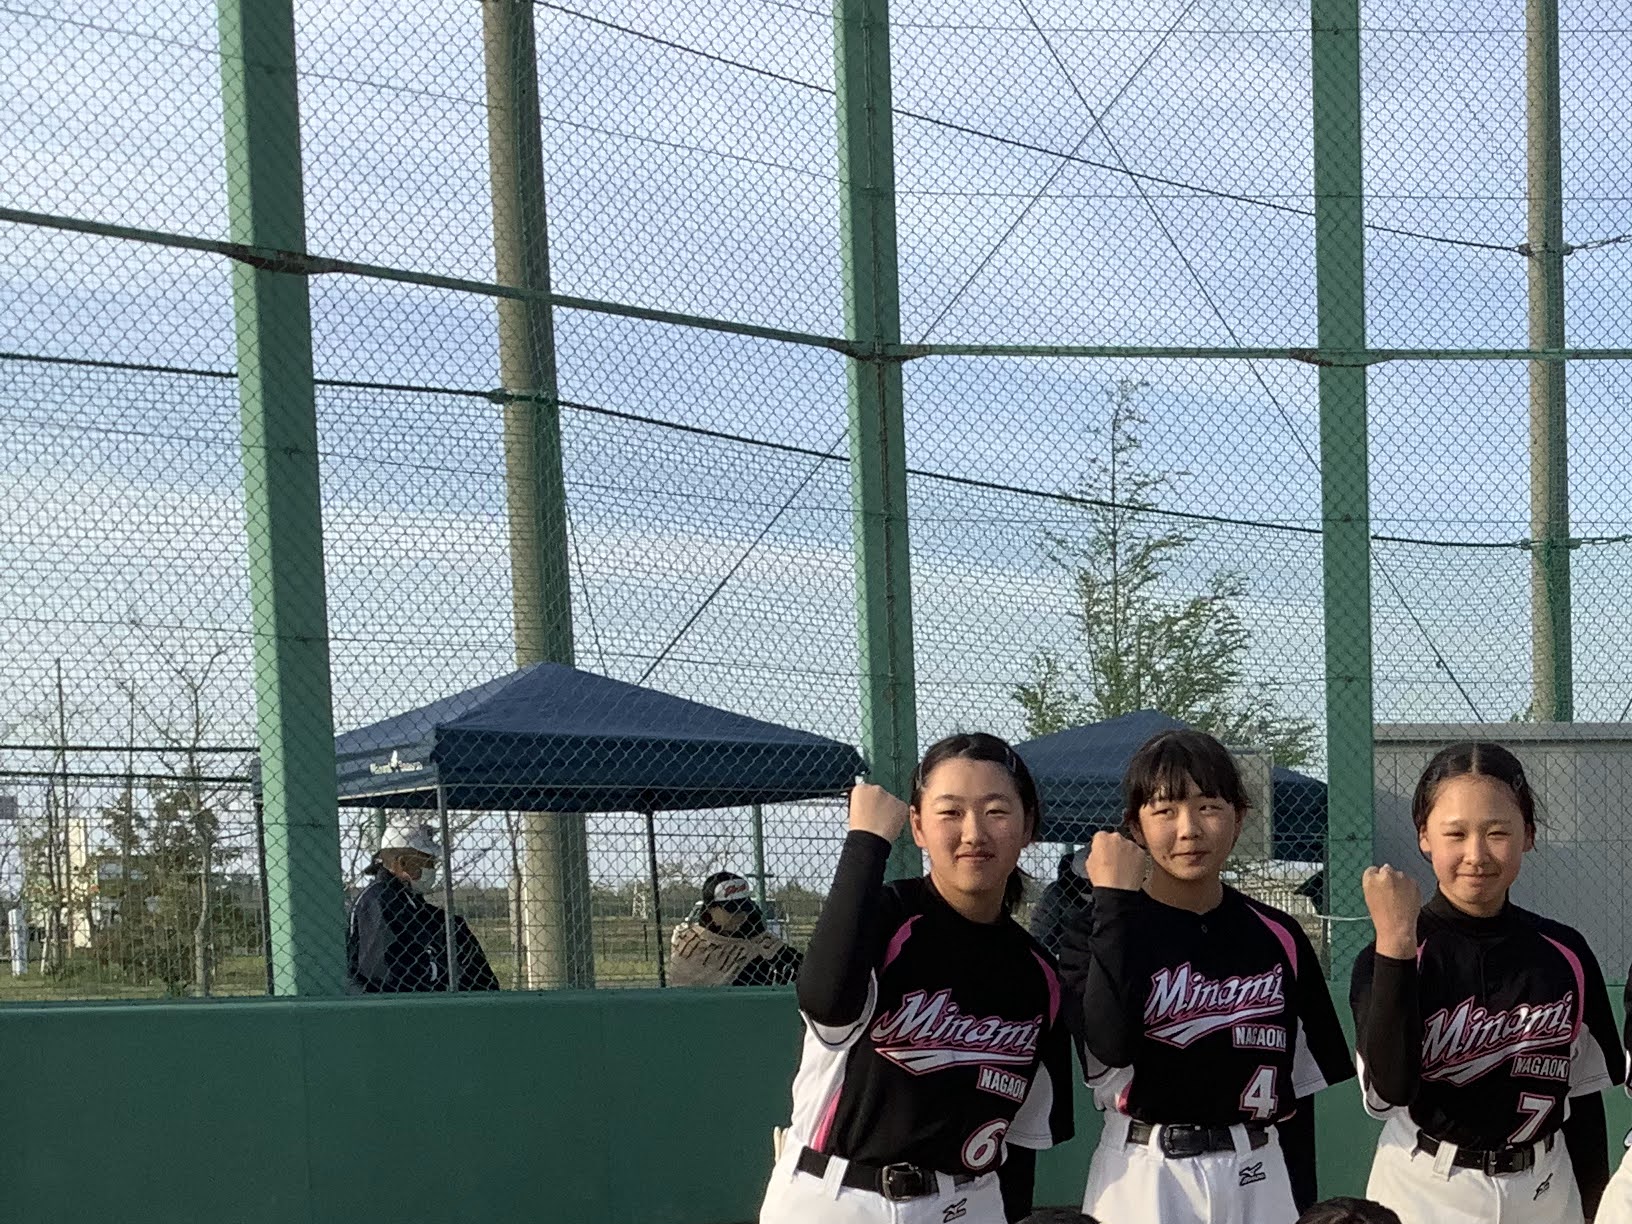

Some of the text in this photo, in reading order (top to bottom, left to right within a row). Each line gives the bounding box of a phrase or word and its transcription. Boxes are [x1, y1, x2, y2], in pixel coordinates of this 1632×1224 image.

[870, 988, 1042, 1050] Minami
[1144, 961, 1285, 1025] Minami
[1422, 990, 1573, 1068] Minami
[1239, 1065, 1278, 1120] 4
[1508, 1092, 1556, 1147] 7
[961, 1119, 1009, 1169] 6
